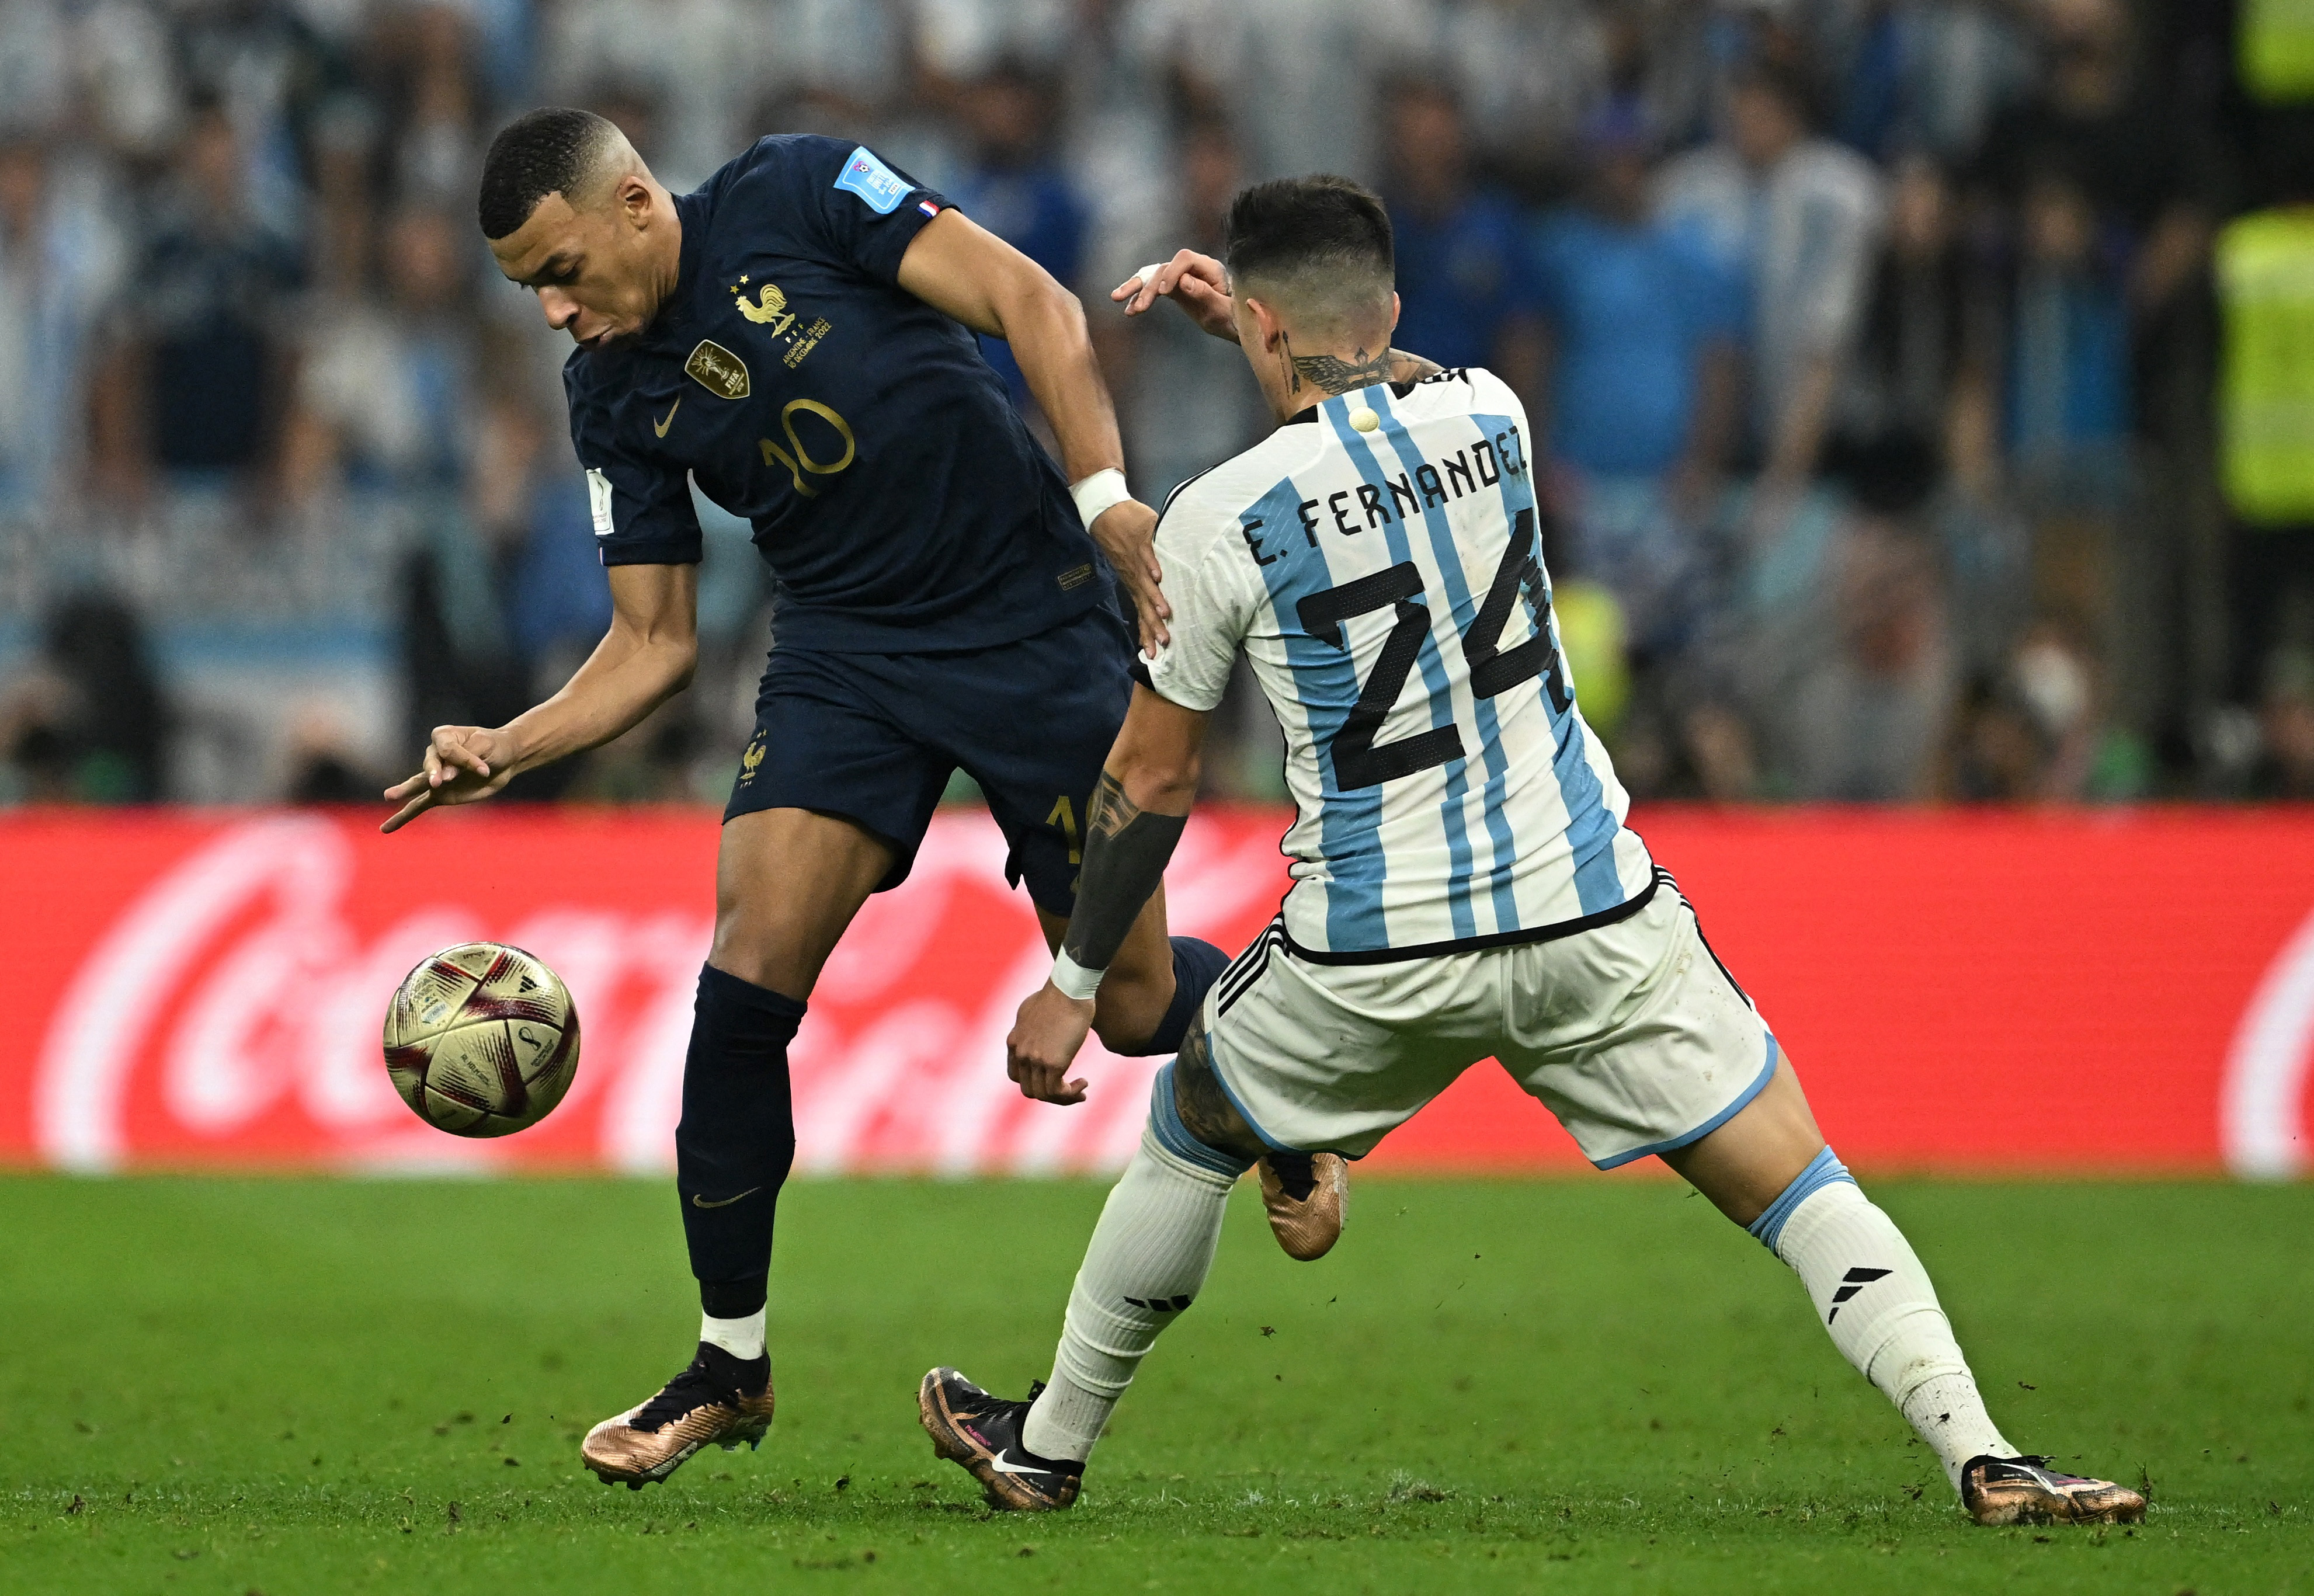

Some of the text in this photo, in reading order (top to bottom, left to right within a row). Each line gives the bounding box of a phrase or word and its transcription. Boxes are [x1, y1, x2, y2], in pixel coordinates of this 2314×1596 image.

[783, 337, 806, 364] ARGENTINE
[806, 316, 826, 336] FRANCE
[815, 322, 832, 339] 2022
[725, 372, 740, 390] FIFA
[759, 398, 854, 499] 10
[1242, 426, 1528, 567] E. FERNANDEZ
[1296, 507, 1572, 792] 24
